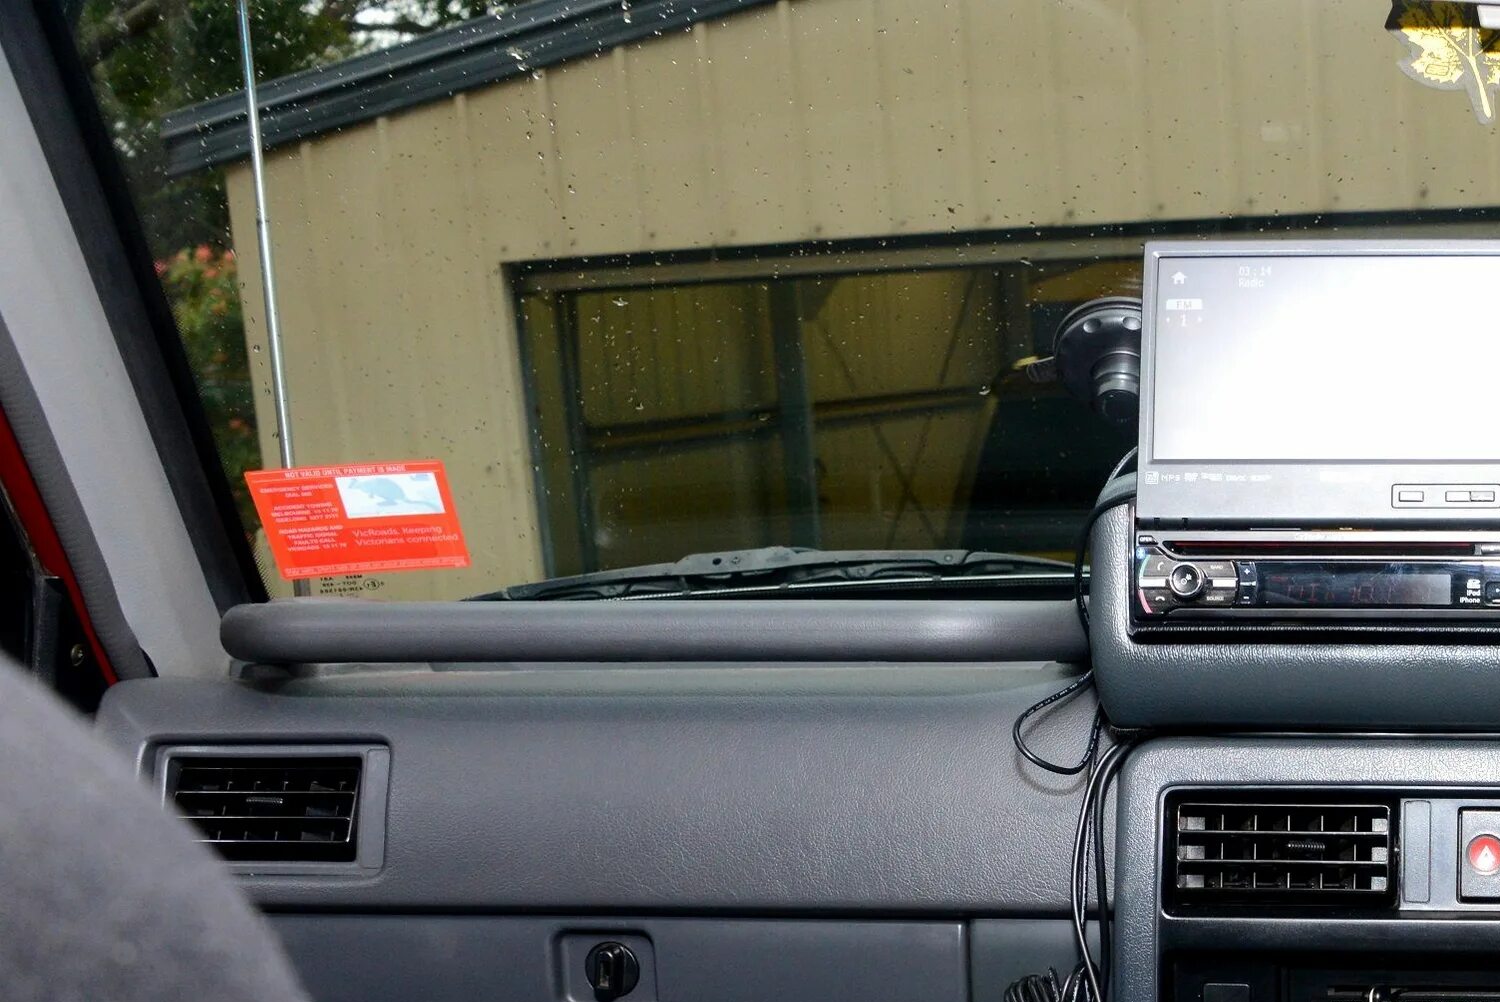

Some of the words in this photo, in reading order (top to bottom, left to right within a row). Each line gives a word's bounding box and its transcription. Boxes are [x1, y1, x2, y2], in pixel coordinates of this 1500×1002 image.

[402, 525, 443, 535] Keeping
[356, 536, 405, 546] Victorians
[408, 534, 458, 543] connected
[1467, 589, 1480, 597] iPod
